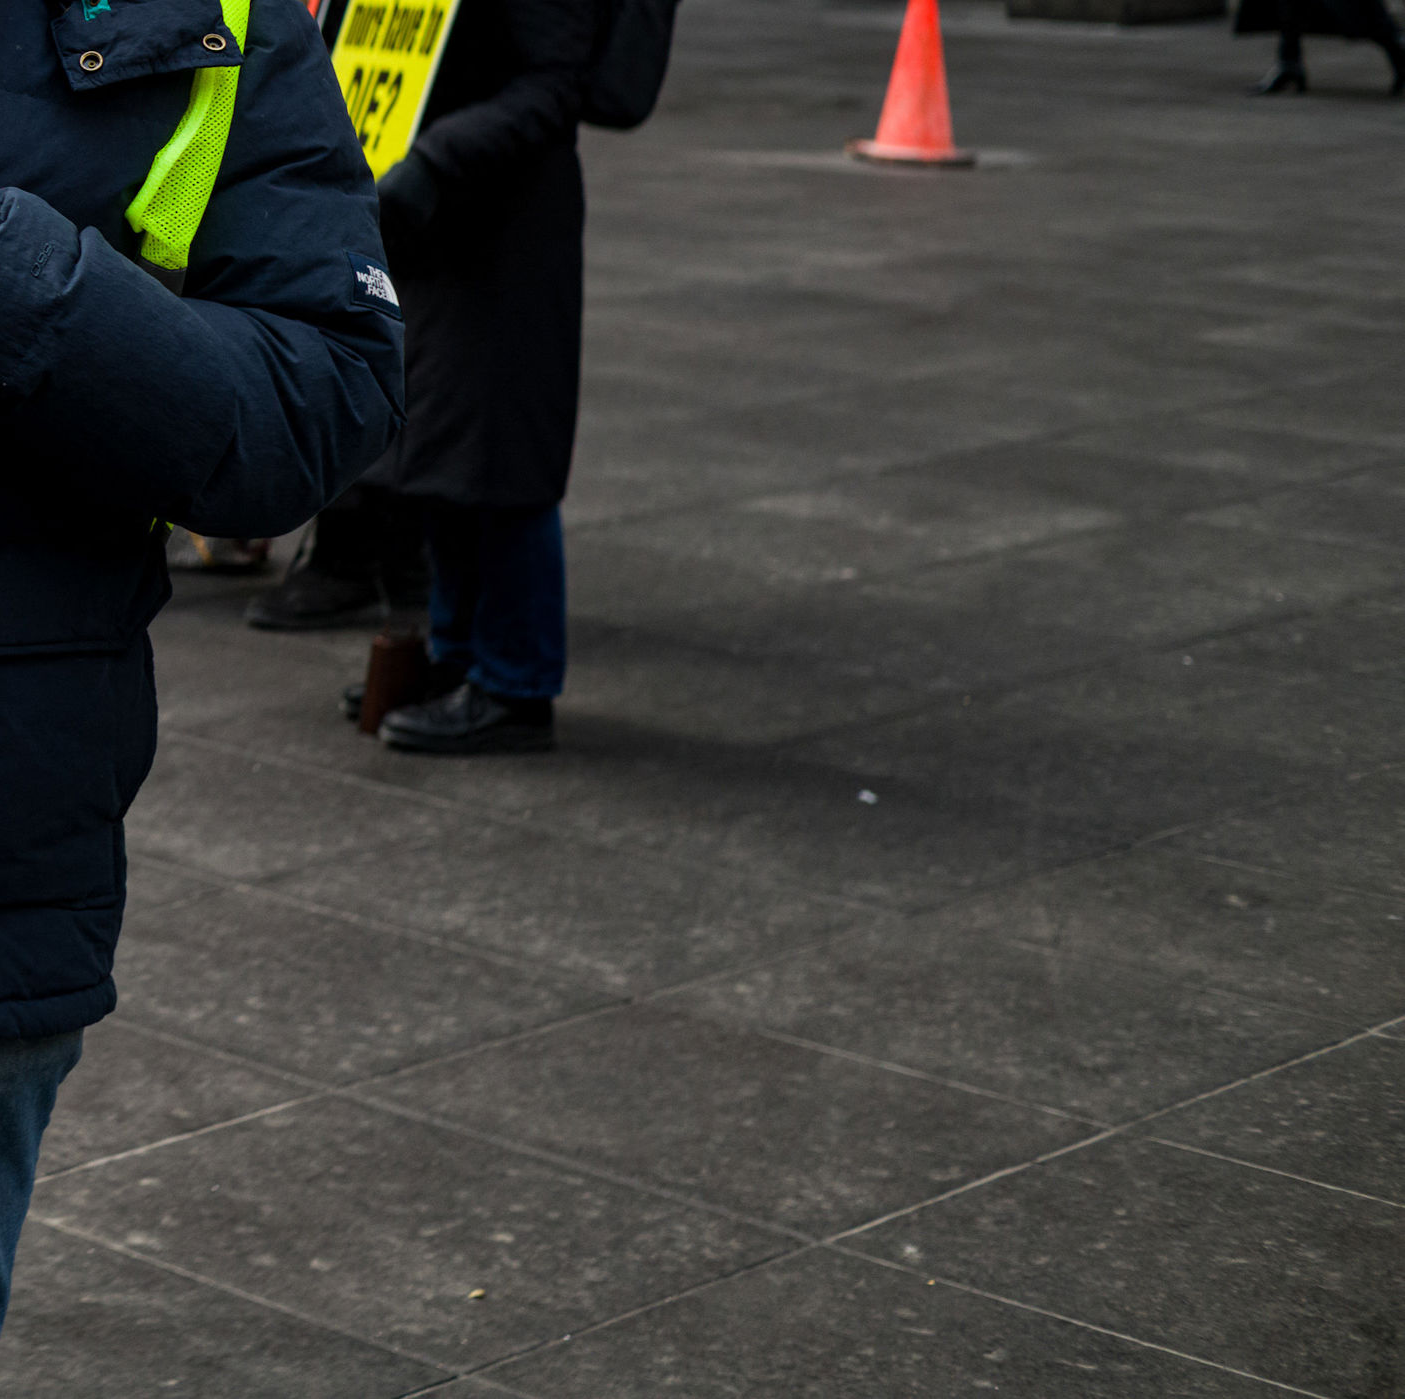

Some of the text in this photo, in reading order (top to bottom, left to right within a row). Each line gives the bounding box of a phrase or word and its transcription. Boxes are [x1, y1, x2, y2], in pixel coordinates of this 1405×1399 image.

[355, 270, 384, 289] NORTH
[366, 264, 384, 280] THE
[367, 284, 388, 300] FACE
